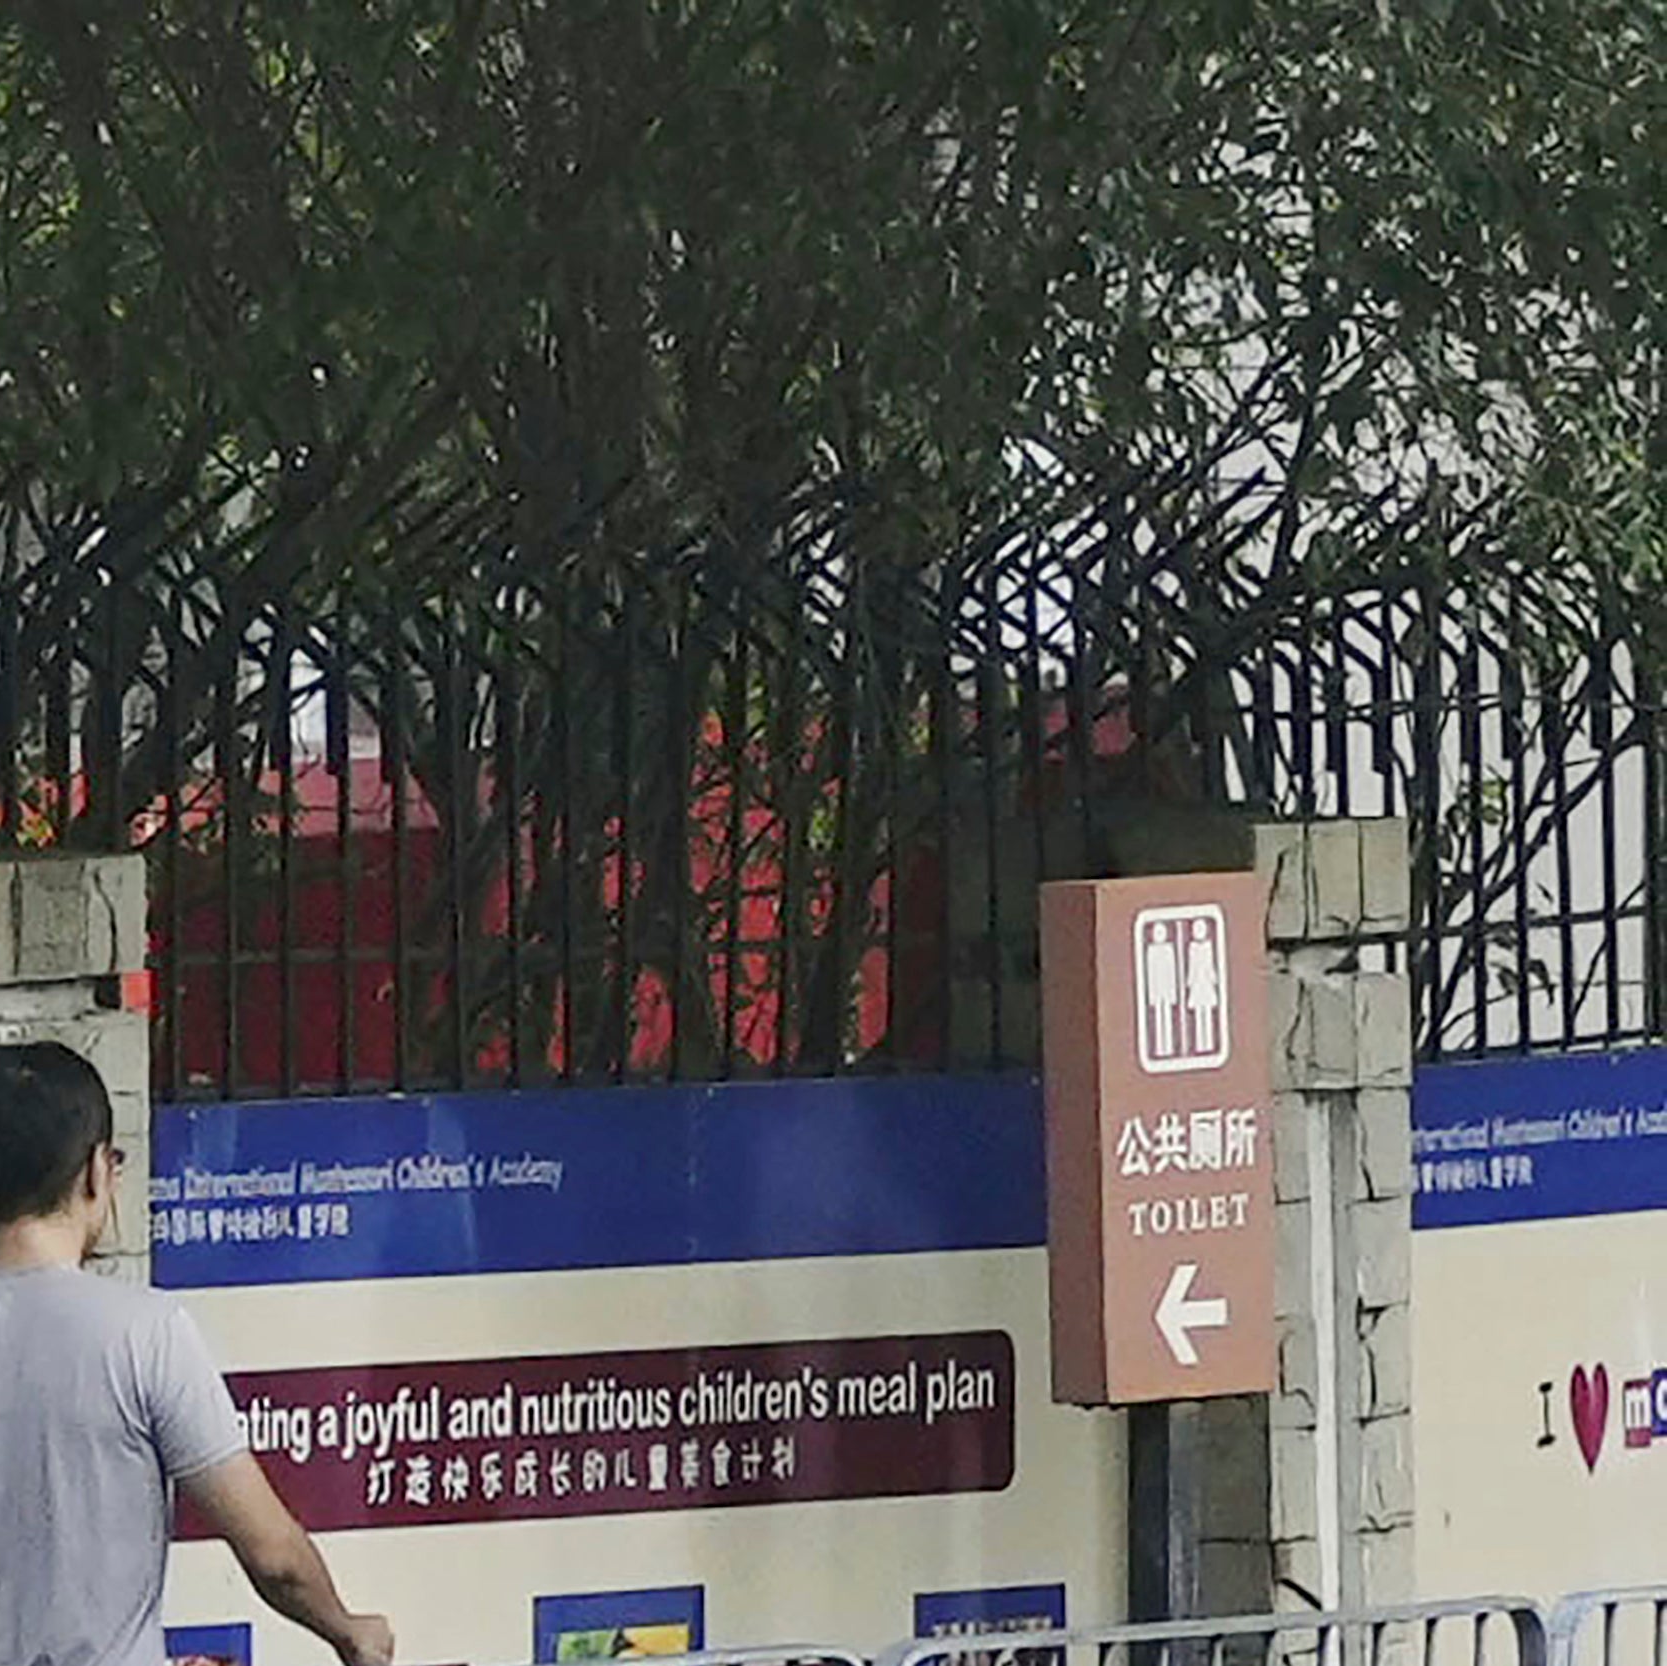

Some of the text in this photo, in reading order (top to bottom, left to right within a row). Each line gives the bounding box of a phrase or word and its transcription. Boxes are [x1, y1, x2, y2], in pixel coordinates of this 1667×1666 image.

[1117, 1109, 1257, 1175] 公共厕所
[1128, 1193, 1249, 1236] TOILET
[318, 1405, 339, 1447] a
[341, 1386, 440, 1460] joyful
[448, 1381, 514, 1440] and
[520, 1376, 670, 1436] nutritious
[678, 1366, 829, 1427] children's
[836, 1360, 919, 1415] meal
[925, 1359, 997, 1425] plan
